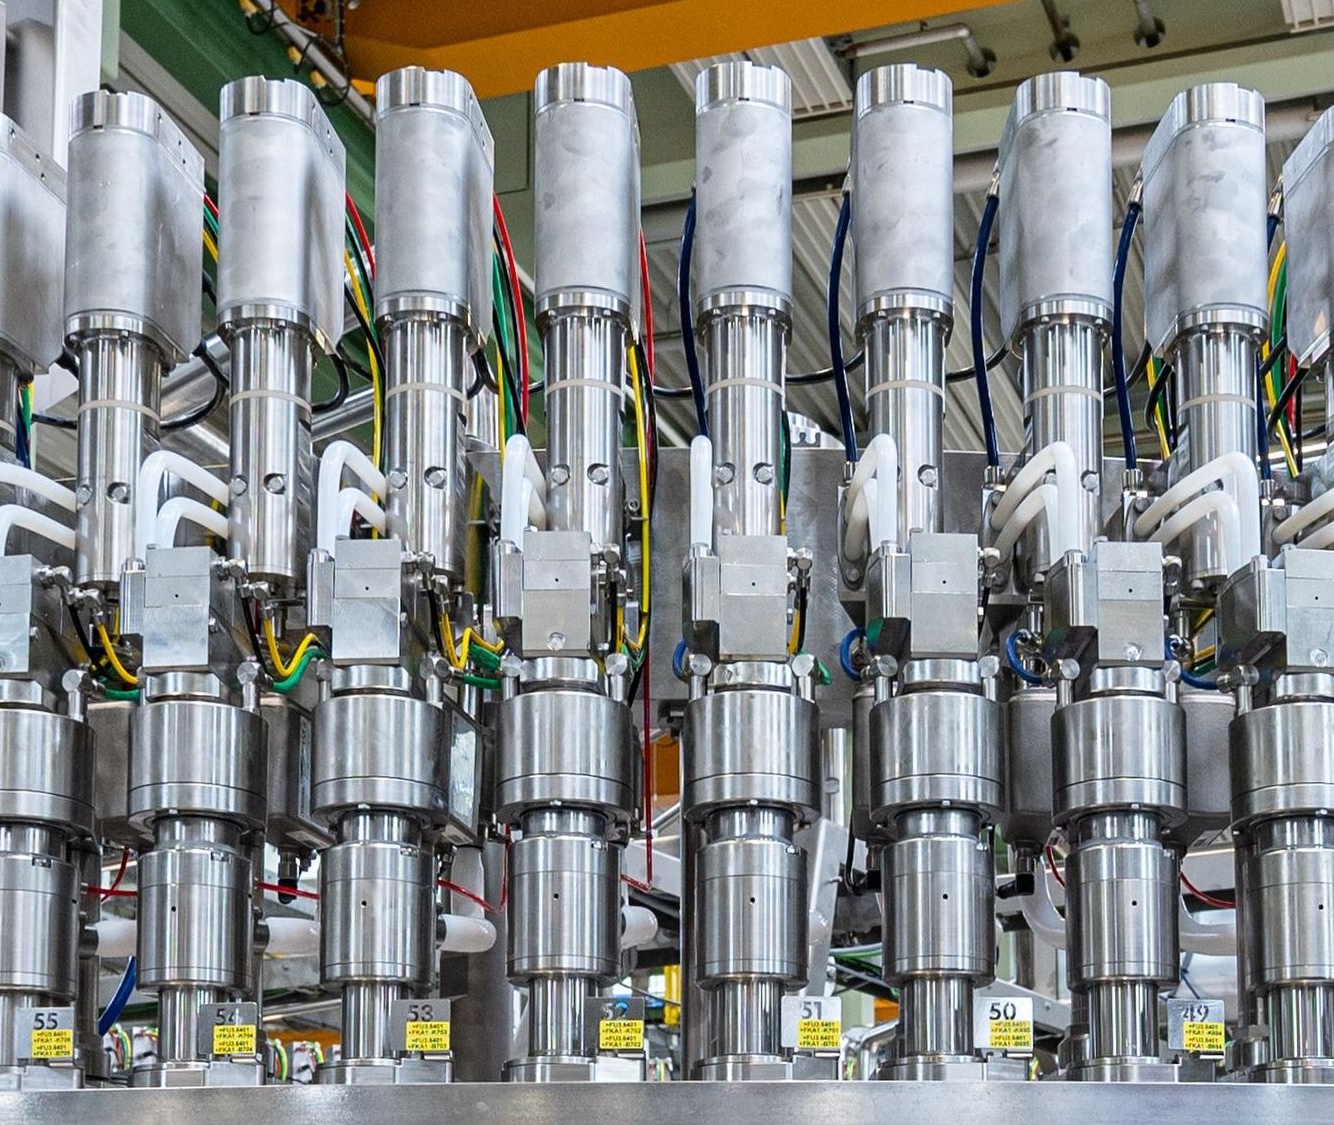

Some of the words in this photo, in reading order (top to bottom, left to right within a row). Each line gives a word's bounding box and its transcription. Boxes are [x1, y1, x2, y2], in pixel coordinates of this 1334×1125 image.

[216, 1008, 241, 1025] 54
[407, 1004, 433, 1021] 53
[602, 1002, 628, 1020] 52
[801, 1001, 822, 1019] 51
[989, 1003, 1016, 1020] 50
[1183, 1005, 1209, 1022] 49
[33, 1012, 58, 1029] 55
